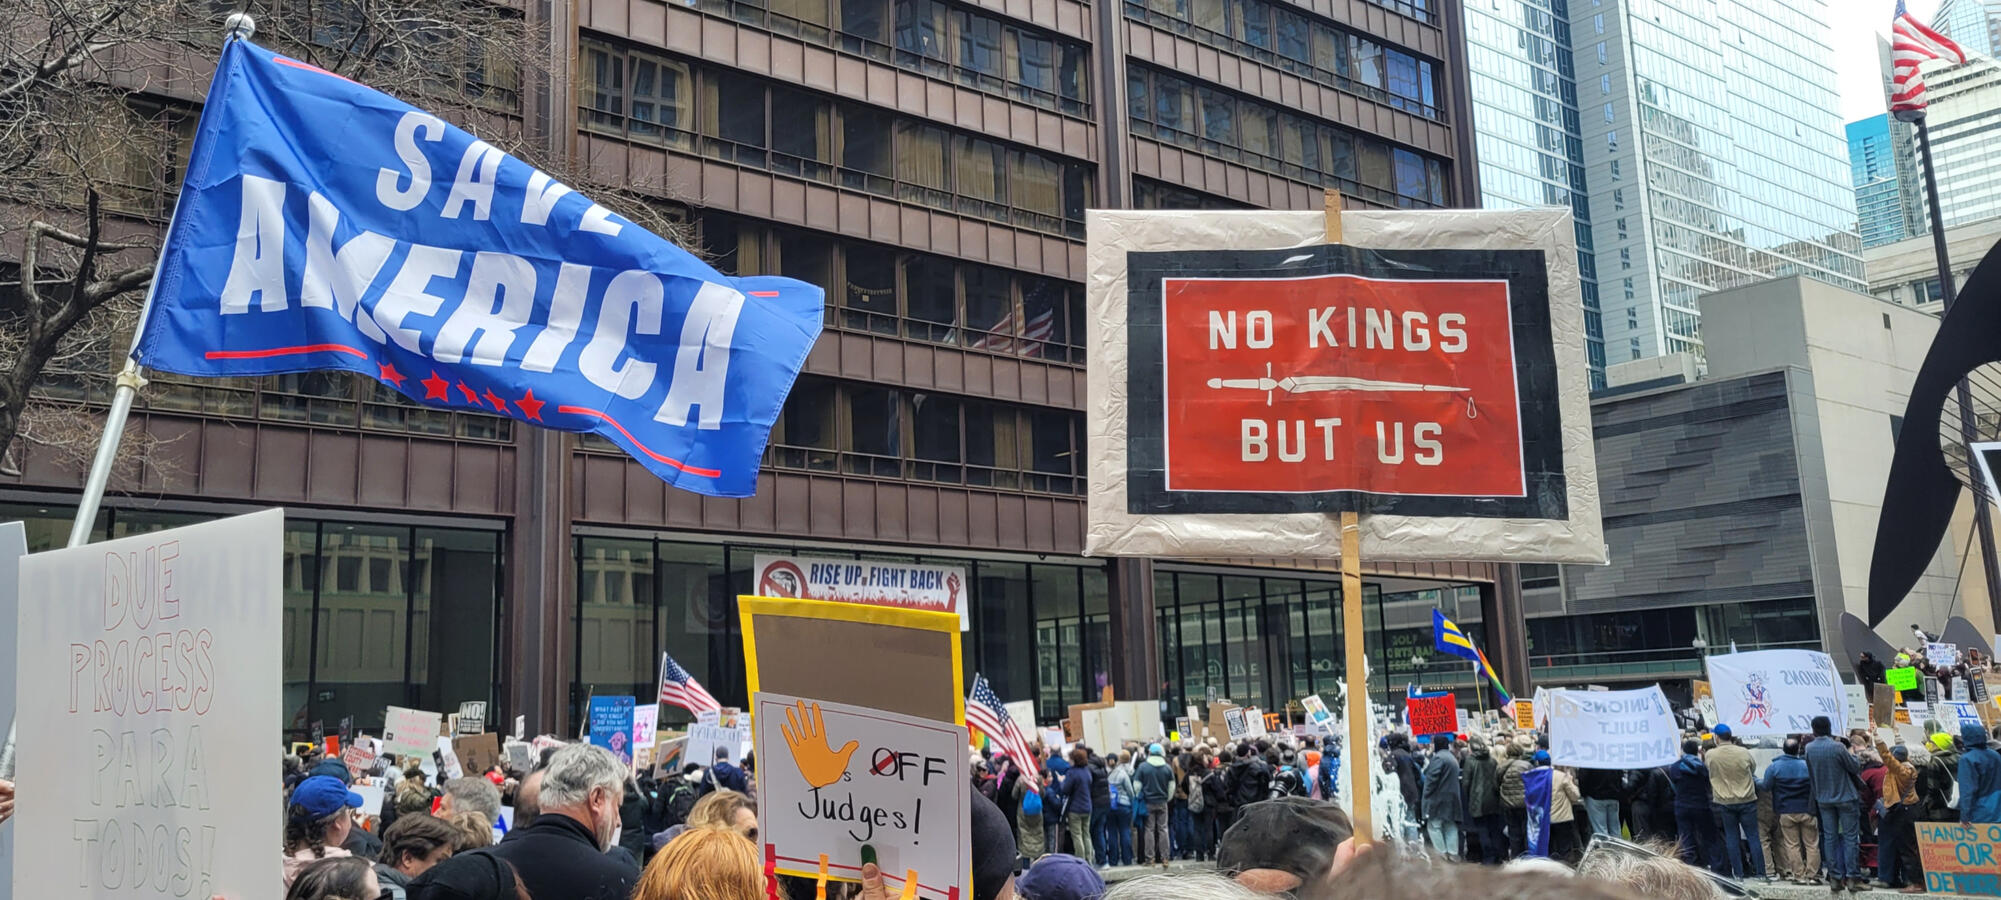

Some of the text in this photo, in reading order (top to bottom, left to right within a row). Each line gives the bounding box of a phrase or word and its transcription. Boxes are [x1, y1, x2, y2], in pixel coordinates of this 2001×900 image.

[219, 174, 746, 430] AMERICA
[1209, 305, 1468, 354] NO KINGS
[1240, 417, 1444, 466] BUT US
[104, 540, 181, 631] DUE
[810, 562, 944, 591] RISE UP FIGHT BACK
[69, 628, 215, 717] PROCESS
[461, 703, 485, 720] NO!
[1413, 705, 1449, 717] AMERICA
[90, 725, 210, 811] PARA
[798, 786, 922, 845] Judges!
[1920, 825, 1978, 843] HANDS
[73, 817, 216, 900] TODOS!
[1955, 842, 1998, 866] OUR
